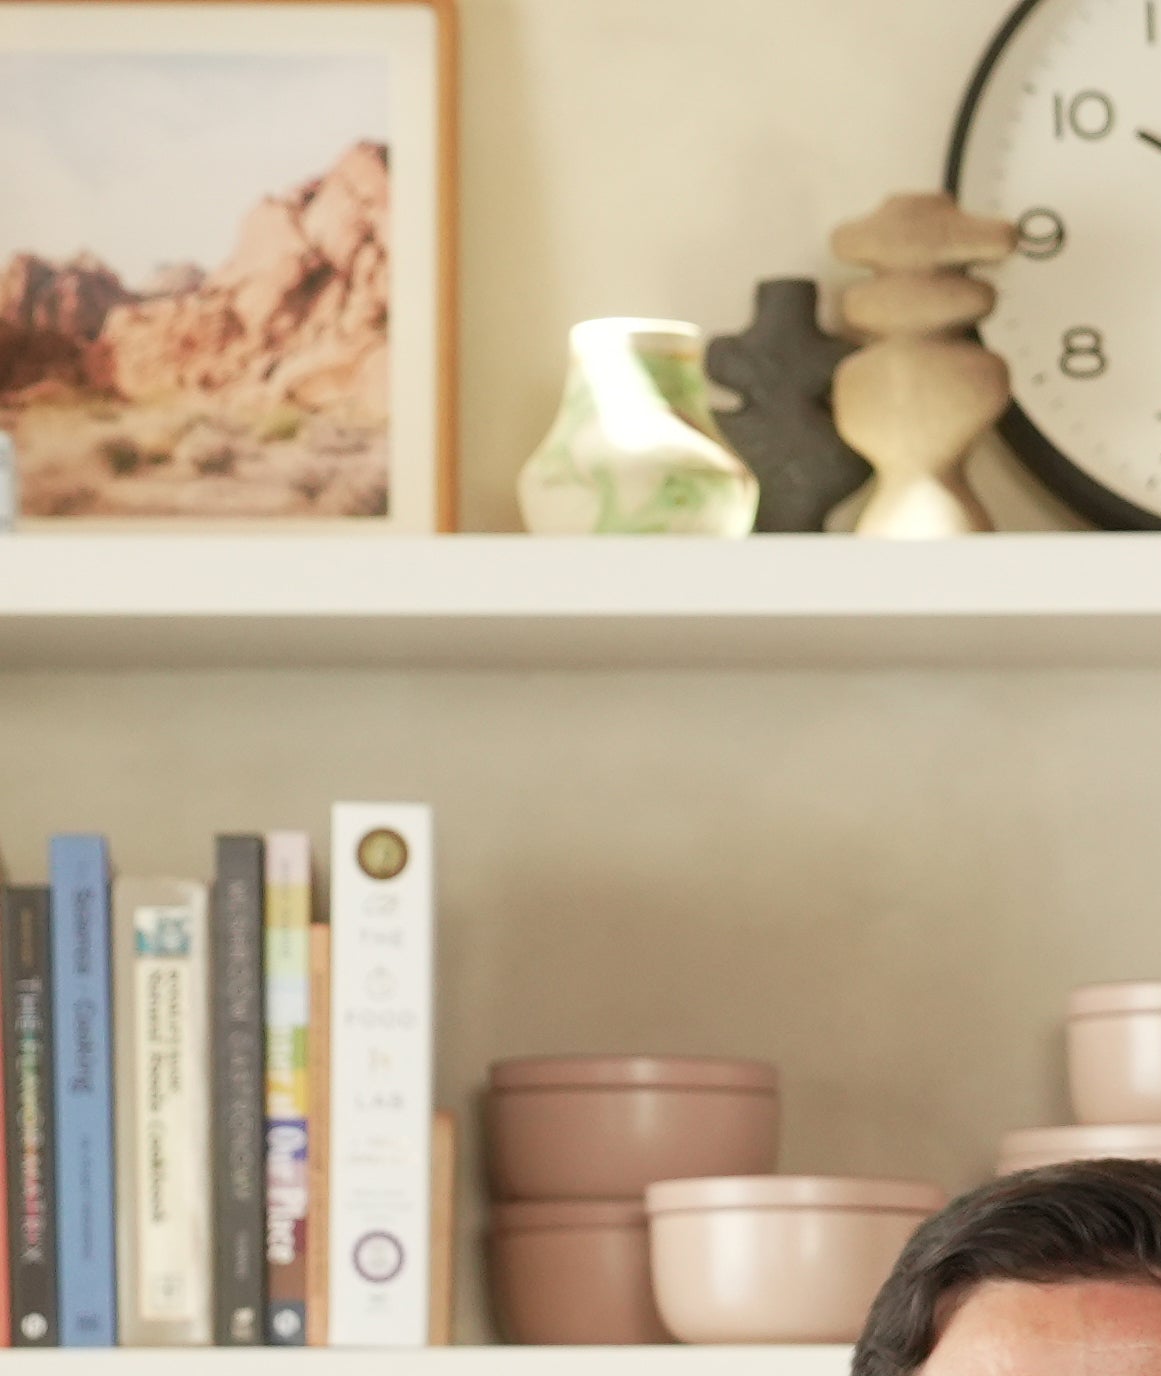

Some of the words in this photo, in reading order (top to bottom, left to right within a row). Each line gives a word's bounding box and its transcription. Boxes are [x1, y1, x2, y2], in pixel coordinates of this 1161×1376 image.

[1052, 90, 1114, 141] 10
[1016, 208, 1064, 259] 9
[1059, 327, 1106, 379] 8
[16, 976, 42, 1031] THE
[71, 998, 97, 1095] Cooking
[266, 1126, 306, 1179] Our
[266, 1187, 306, 1266] Place
